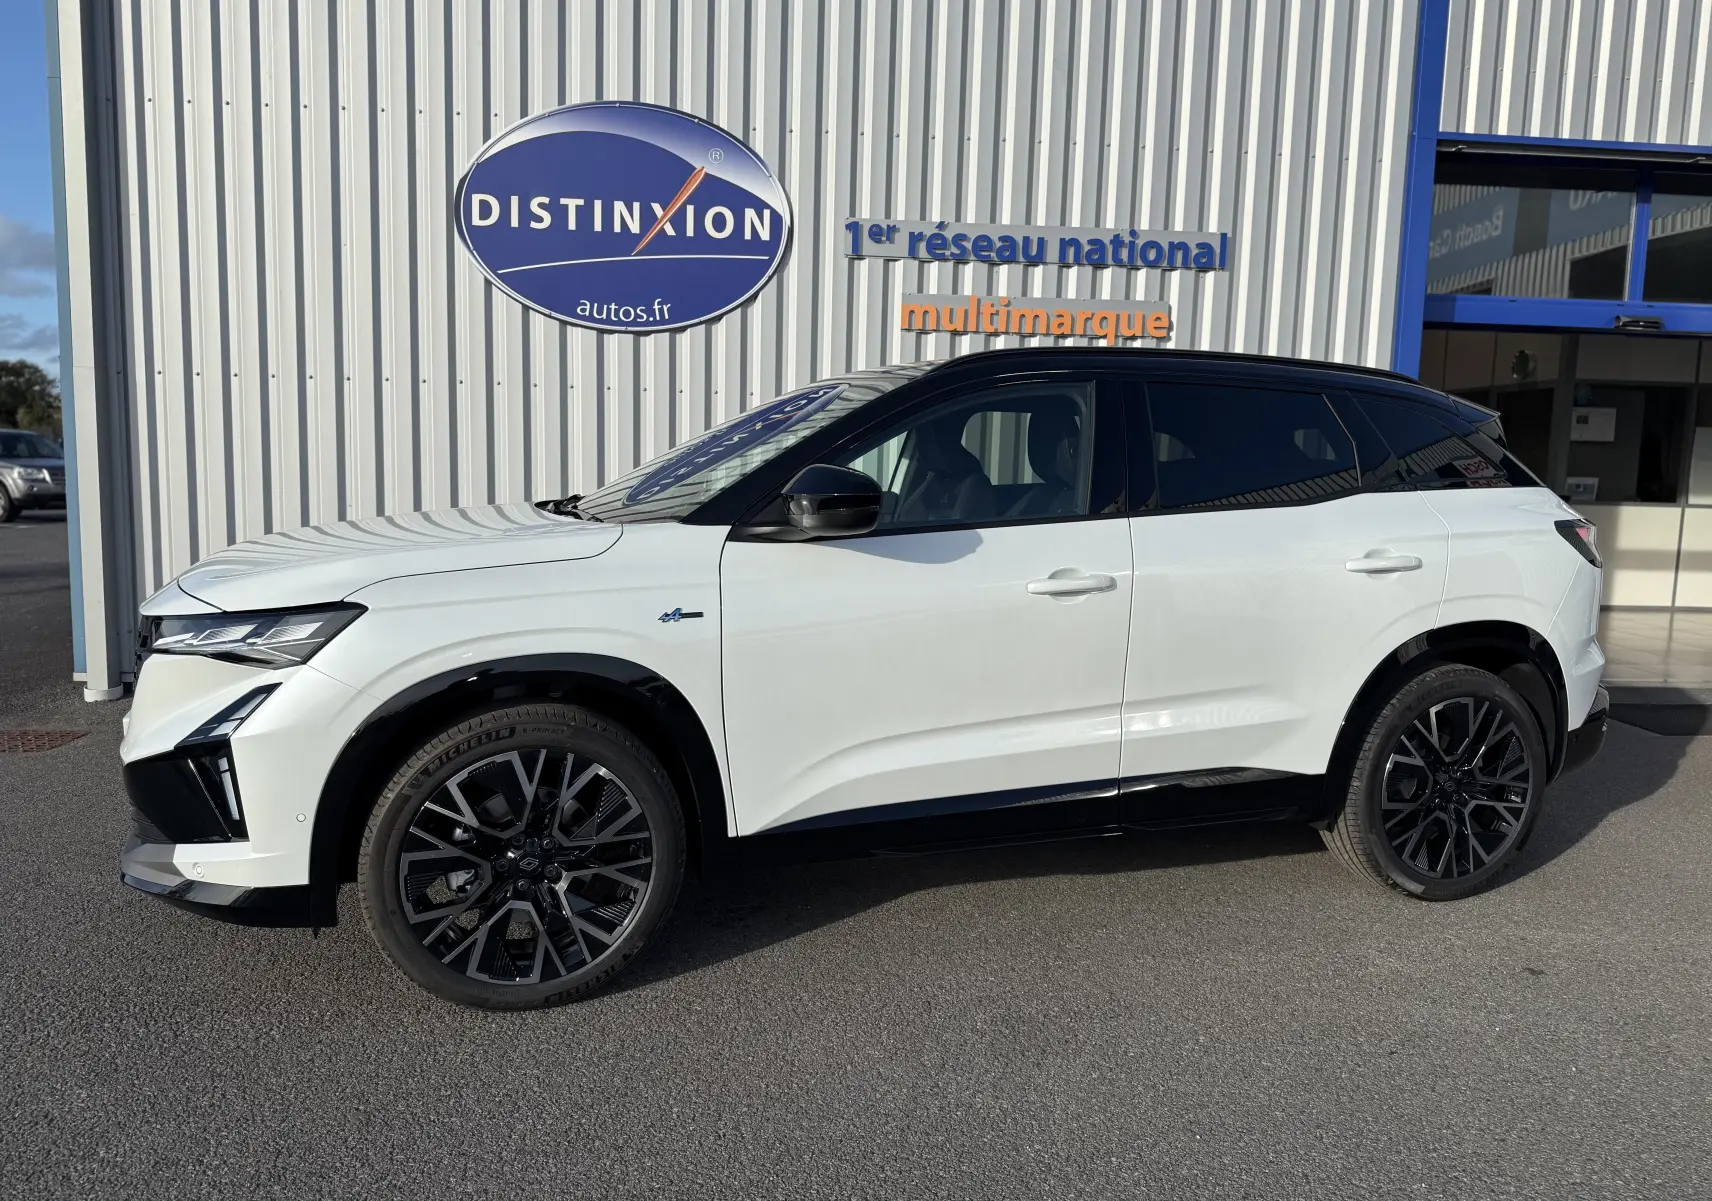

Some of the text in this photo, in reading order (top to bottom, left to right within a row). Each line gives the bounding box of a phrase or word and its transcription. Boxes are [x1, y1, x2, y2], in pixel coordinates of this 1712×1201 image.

[471, 193, 771, 241] DISTINXION
[845, 220, 1228, 270] 1er réseau national
[576, 297, 672, 323] autos.fr
[901, 296, 1170, 346] multimarque
[428, 727, 512, 774] MICHELIN
